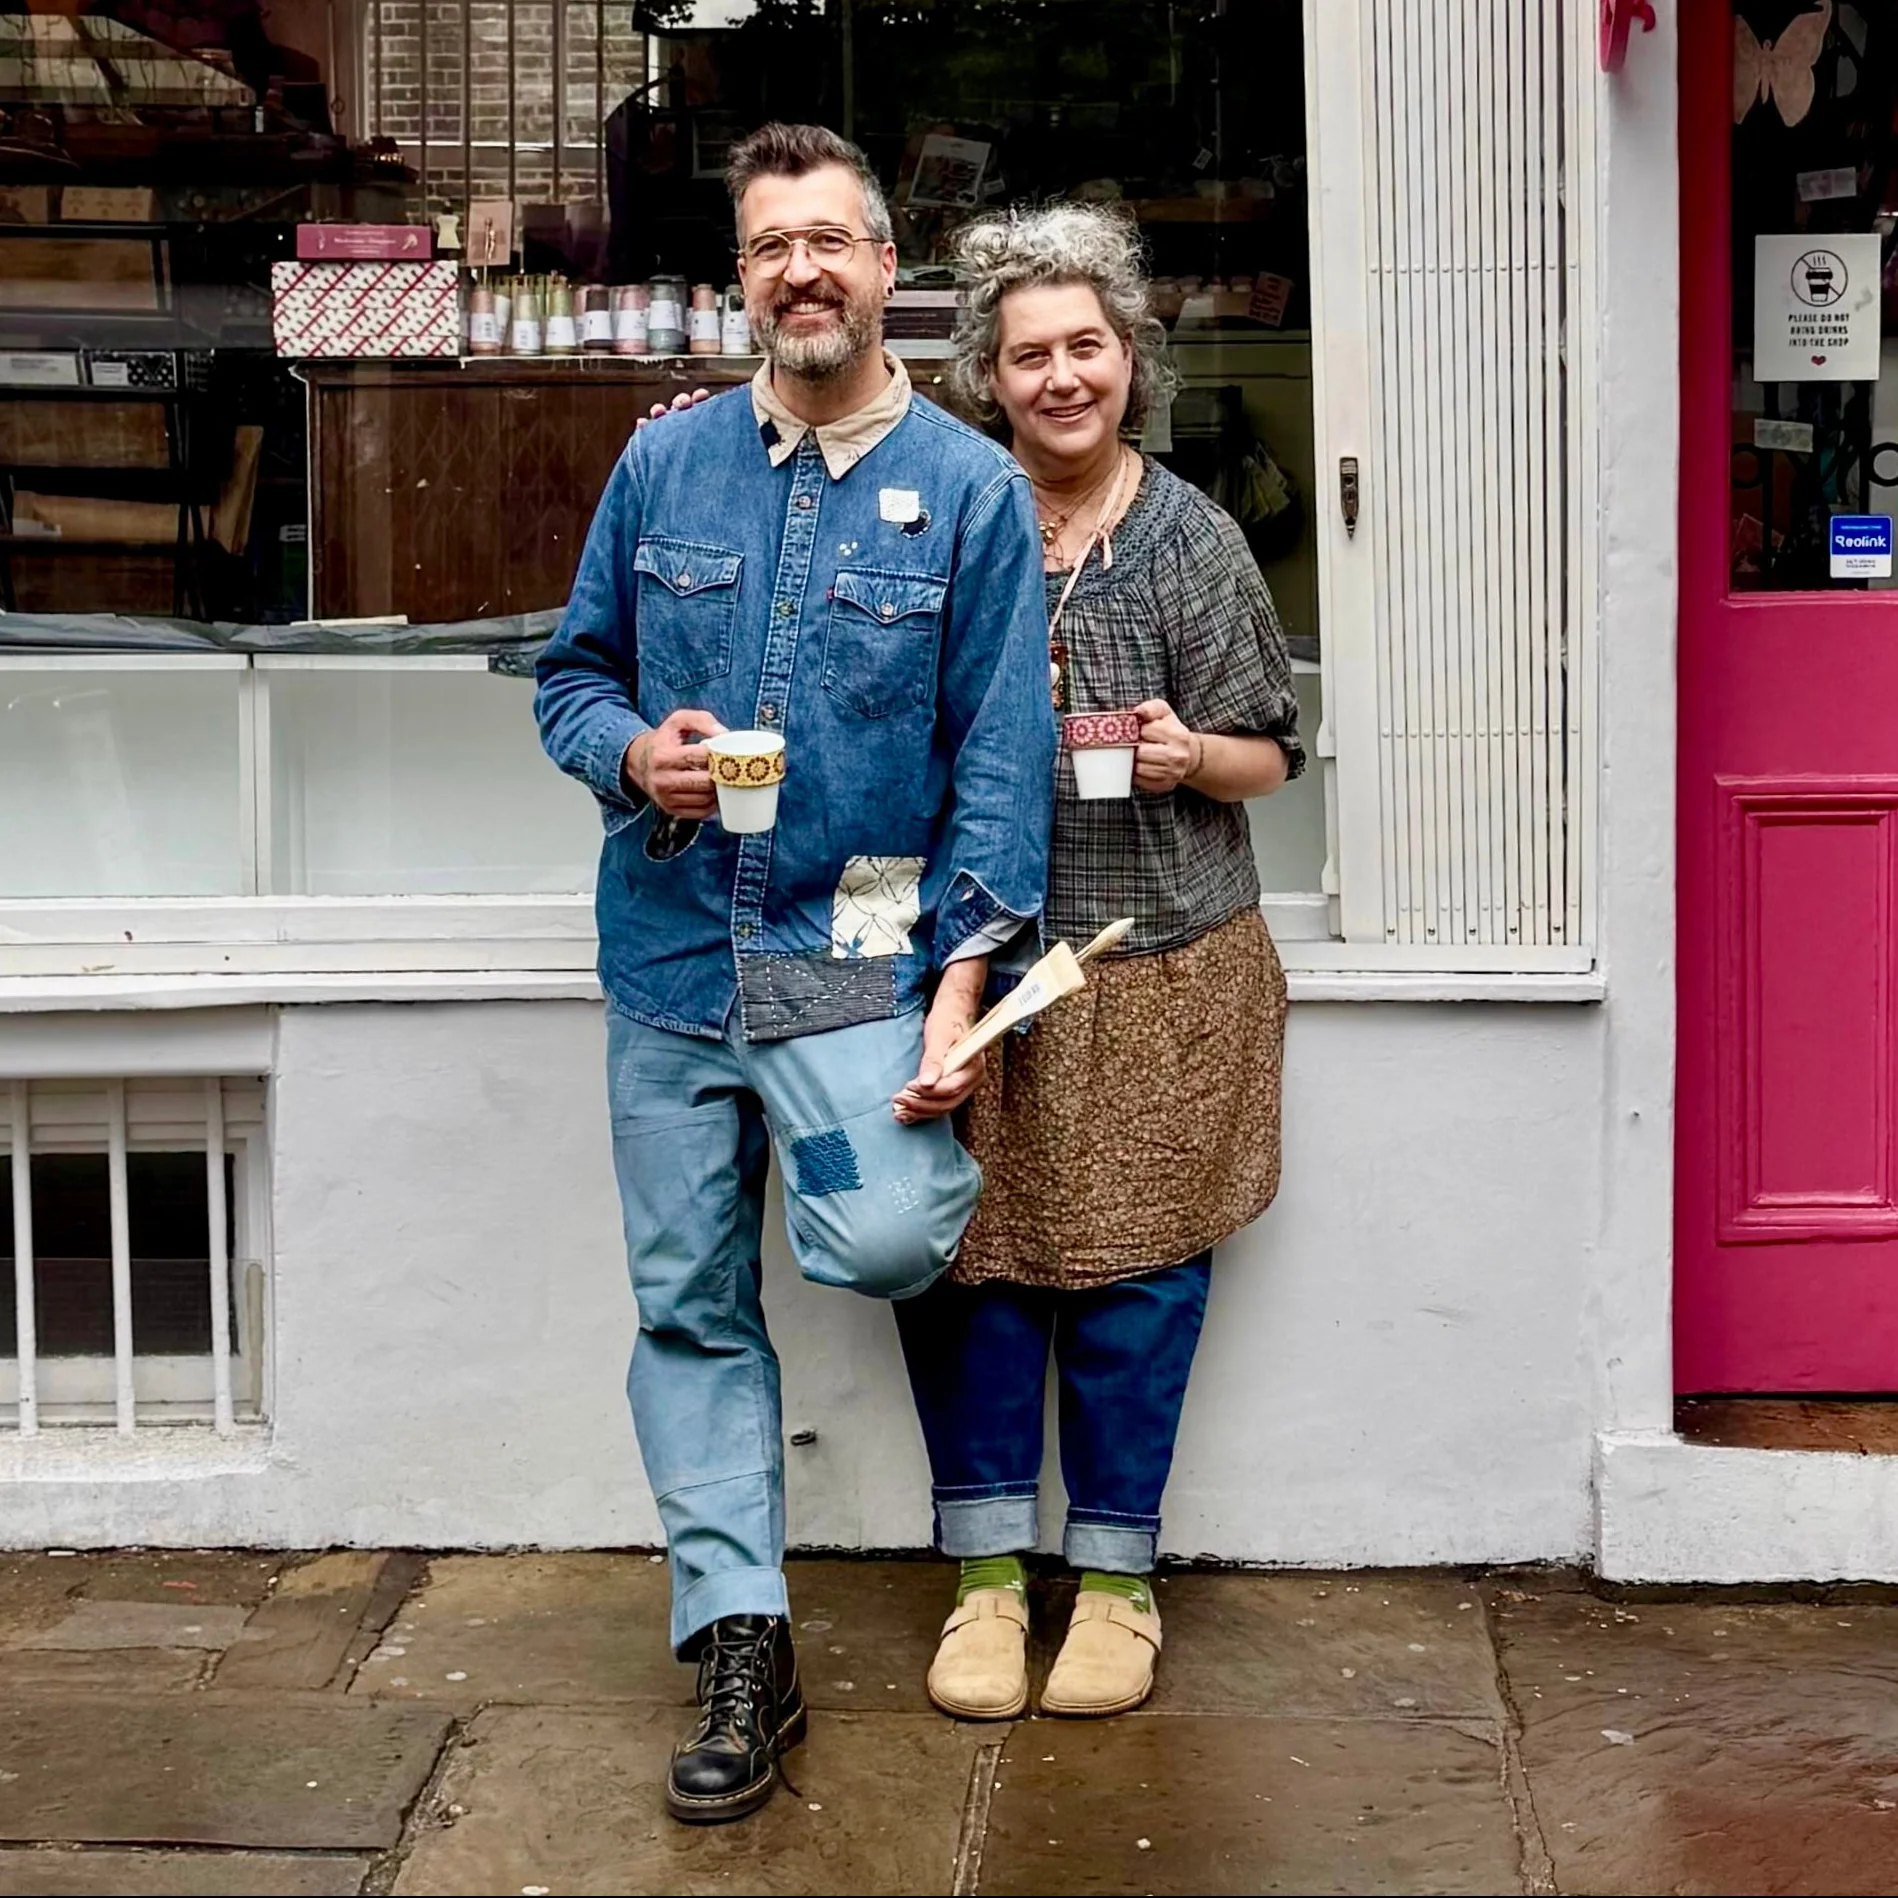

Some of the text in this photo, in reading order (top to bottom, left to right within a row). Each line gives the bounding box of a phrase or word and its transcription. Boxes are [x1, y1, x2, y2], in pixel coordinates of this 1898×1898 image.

[1788, 313, 1849, 322] PLEASE DO NOT
[1790, 325, 1848, 335] BRING DRINKS
[1789, 338, 1849, 347] INTO THE SHOP
[1835, 535, 1887, 548] Reolink
